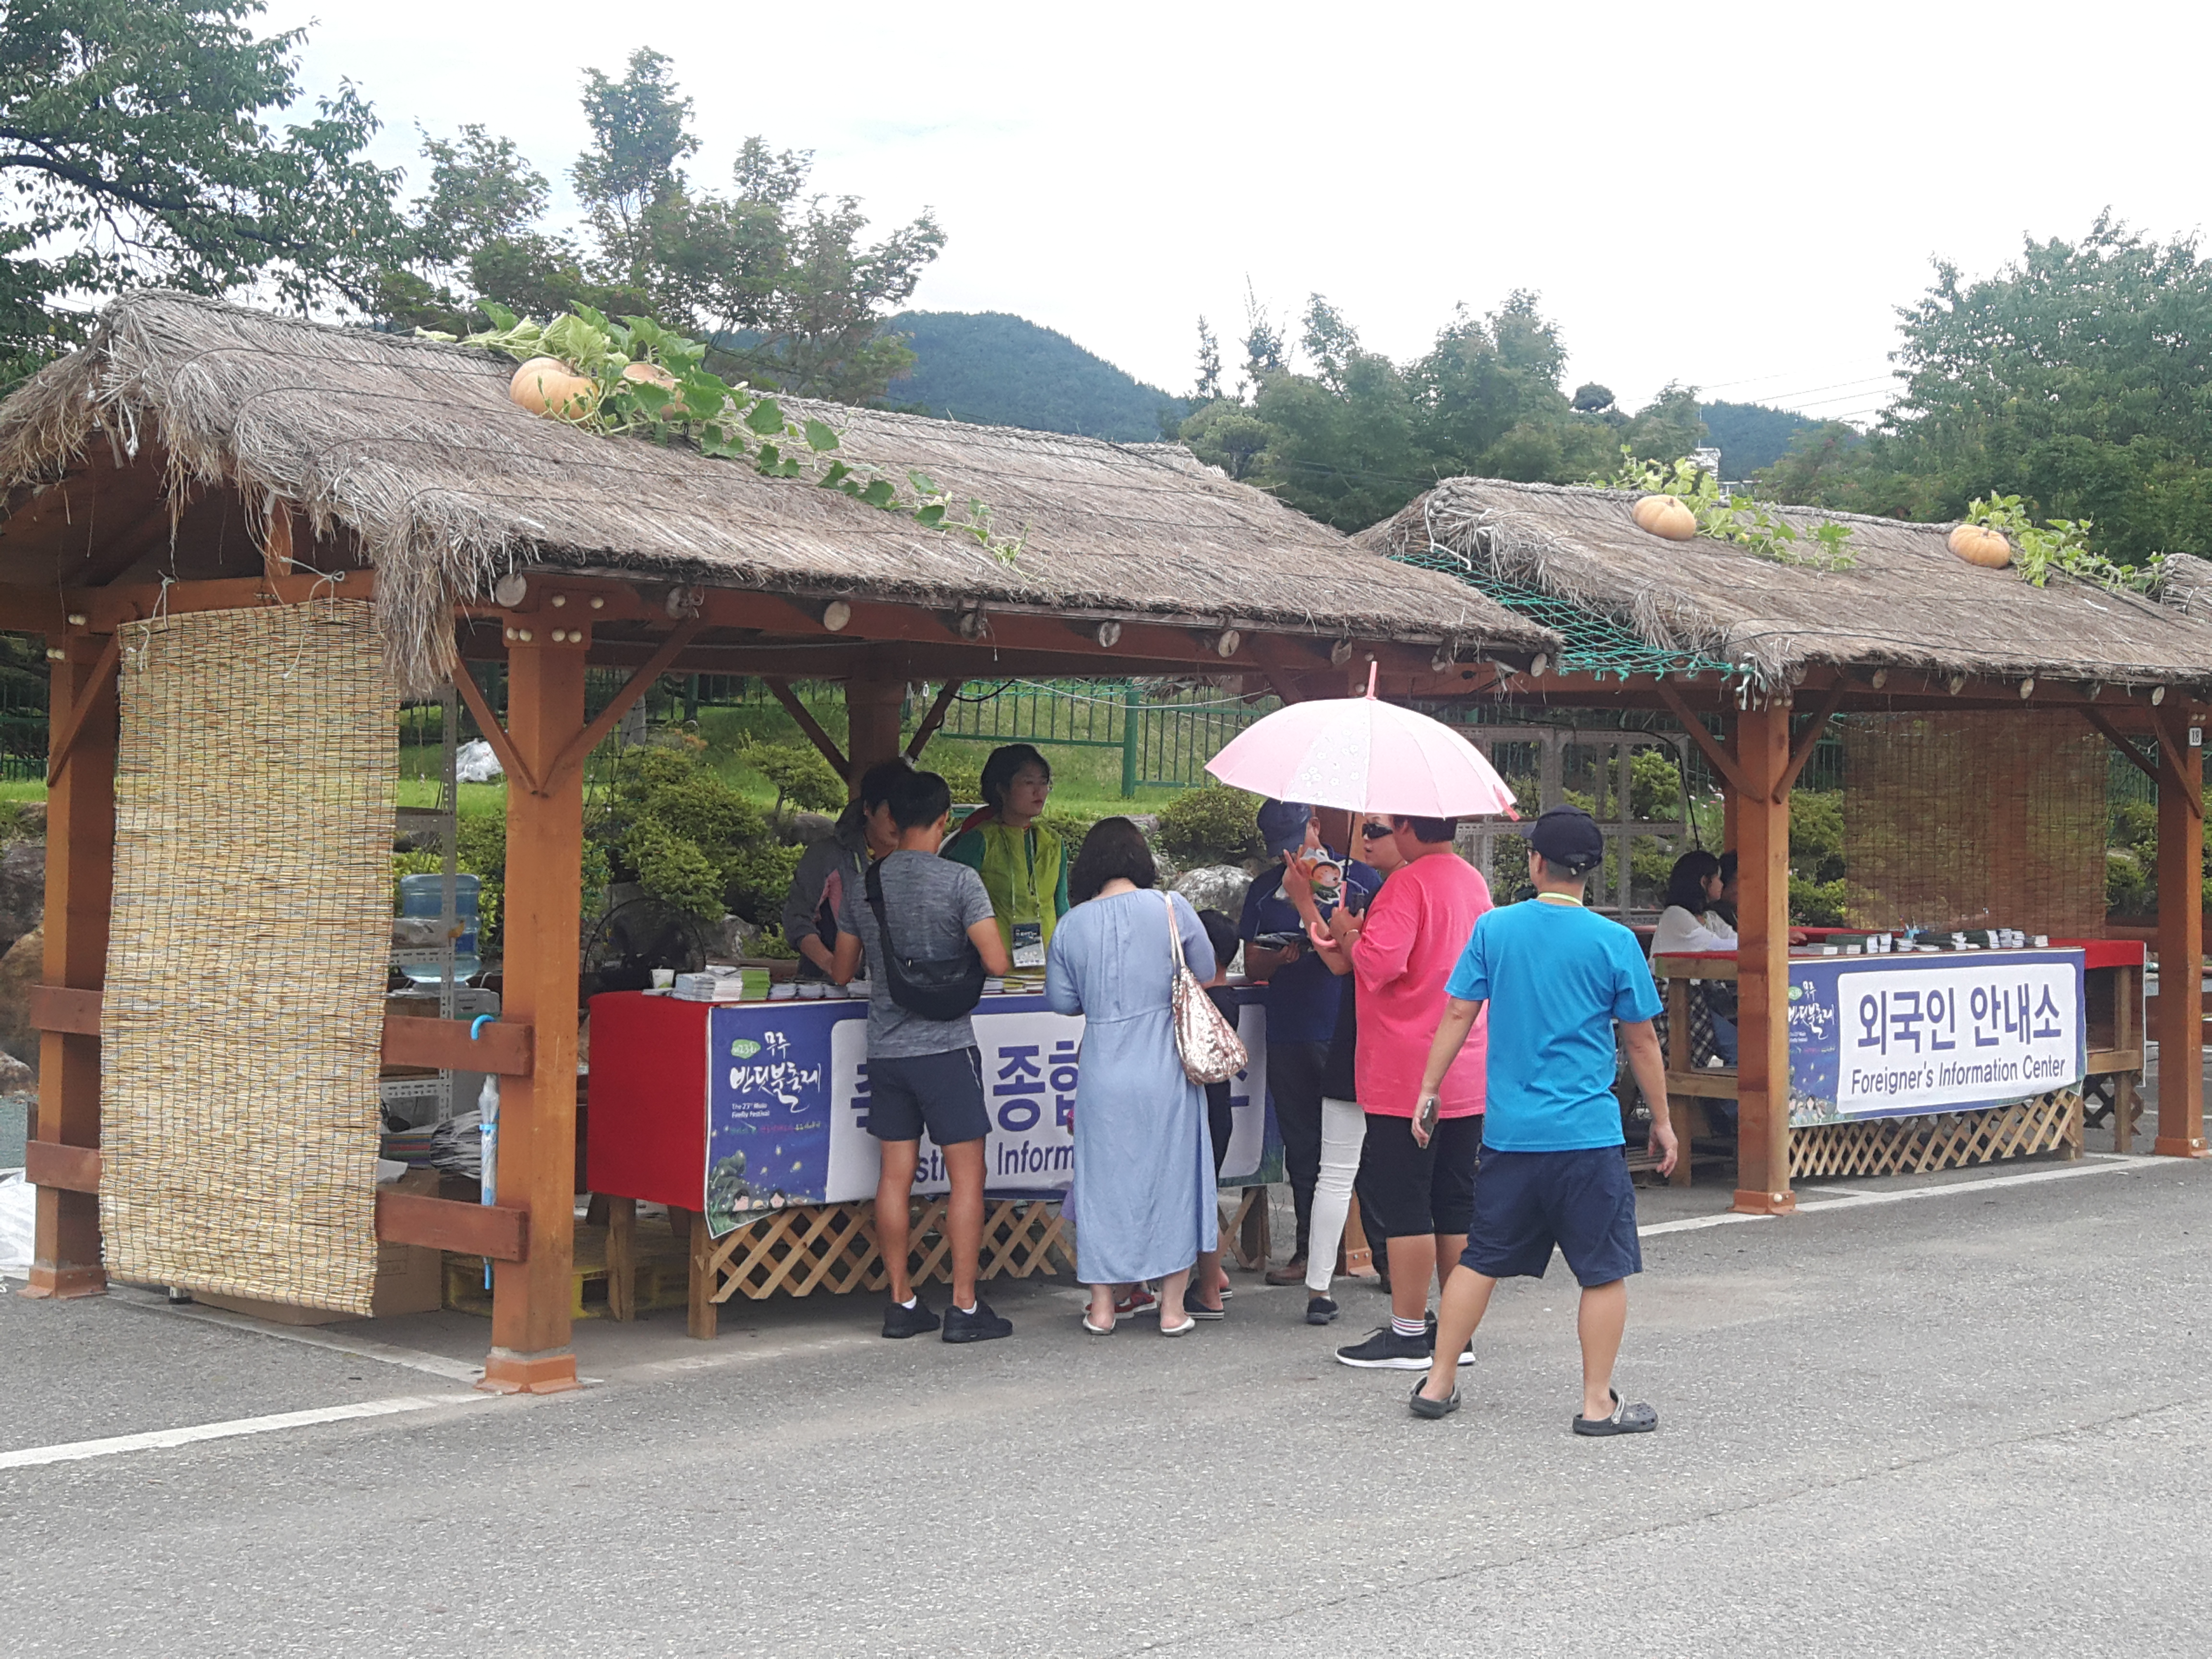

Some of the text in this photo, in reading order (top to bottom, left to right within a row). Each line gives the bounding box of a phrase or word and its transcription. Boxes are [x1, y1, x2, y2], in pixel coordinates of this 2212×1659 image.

[1803, 981, 1816, 1001] 무주
[1858, 983, 2061, 1055] 외국인 안내소
[764, 1032, 791, 1059] 무주
[730, 1061, 821, 1113] 반딧불축제
[1851, 1055, 2065, 1094] Foreigner's Information Center
[998, 1140, 1074, 1176] Inform
